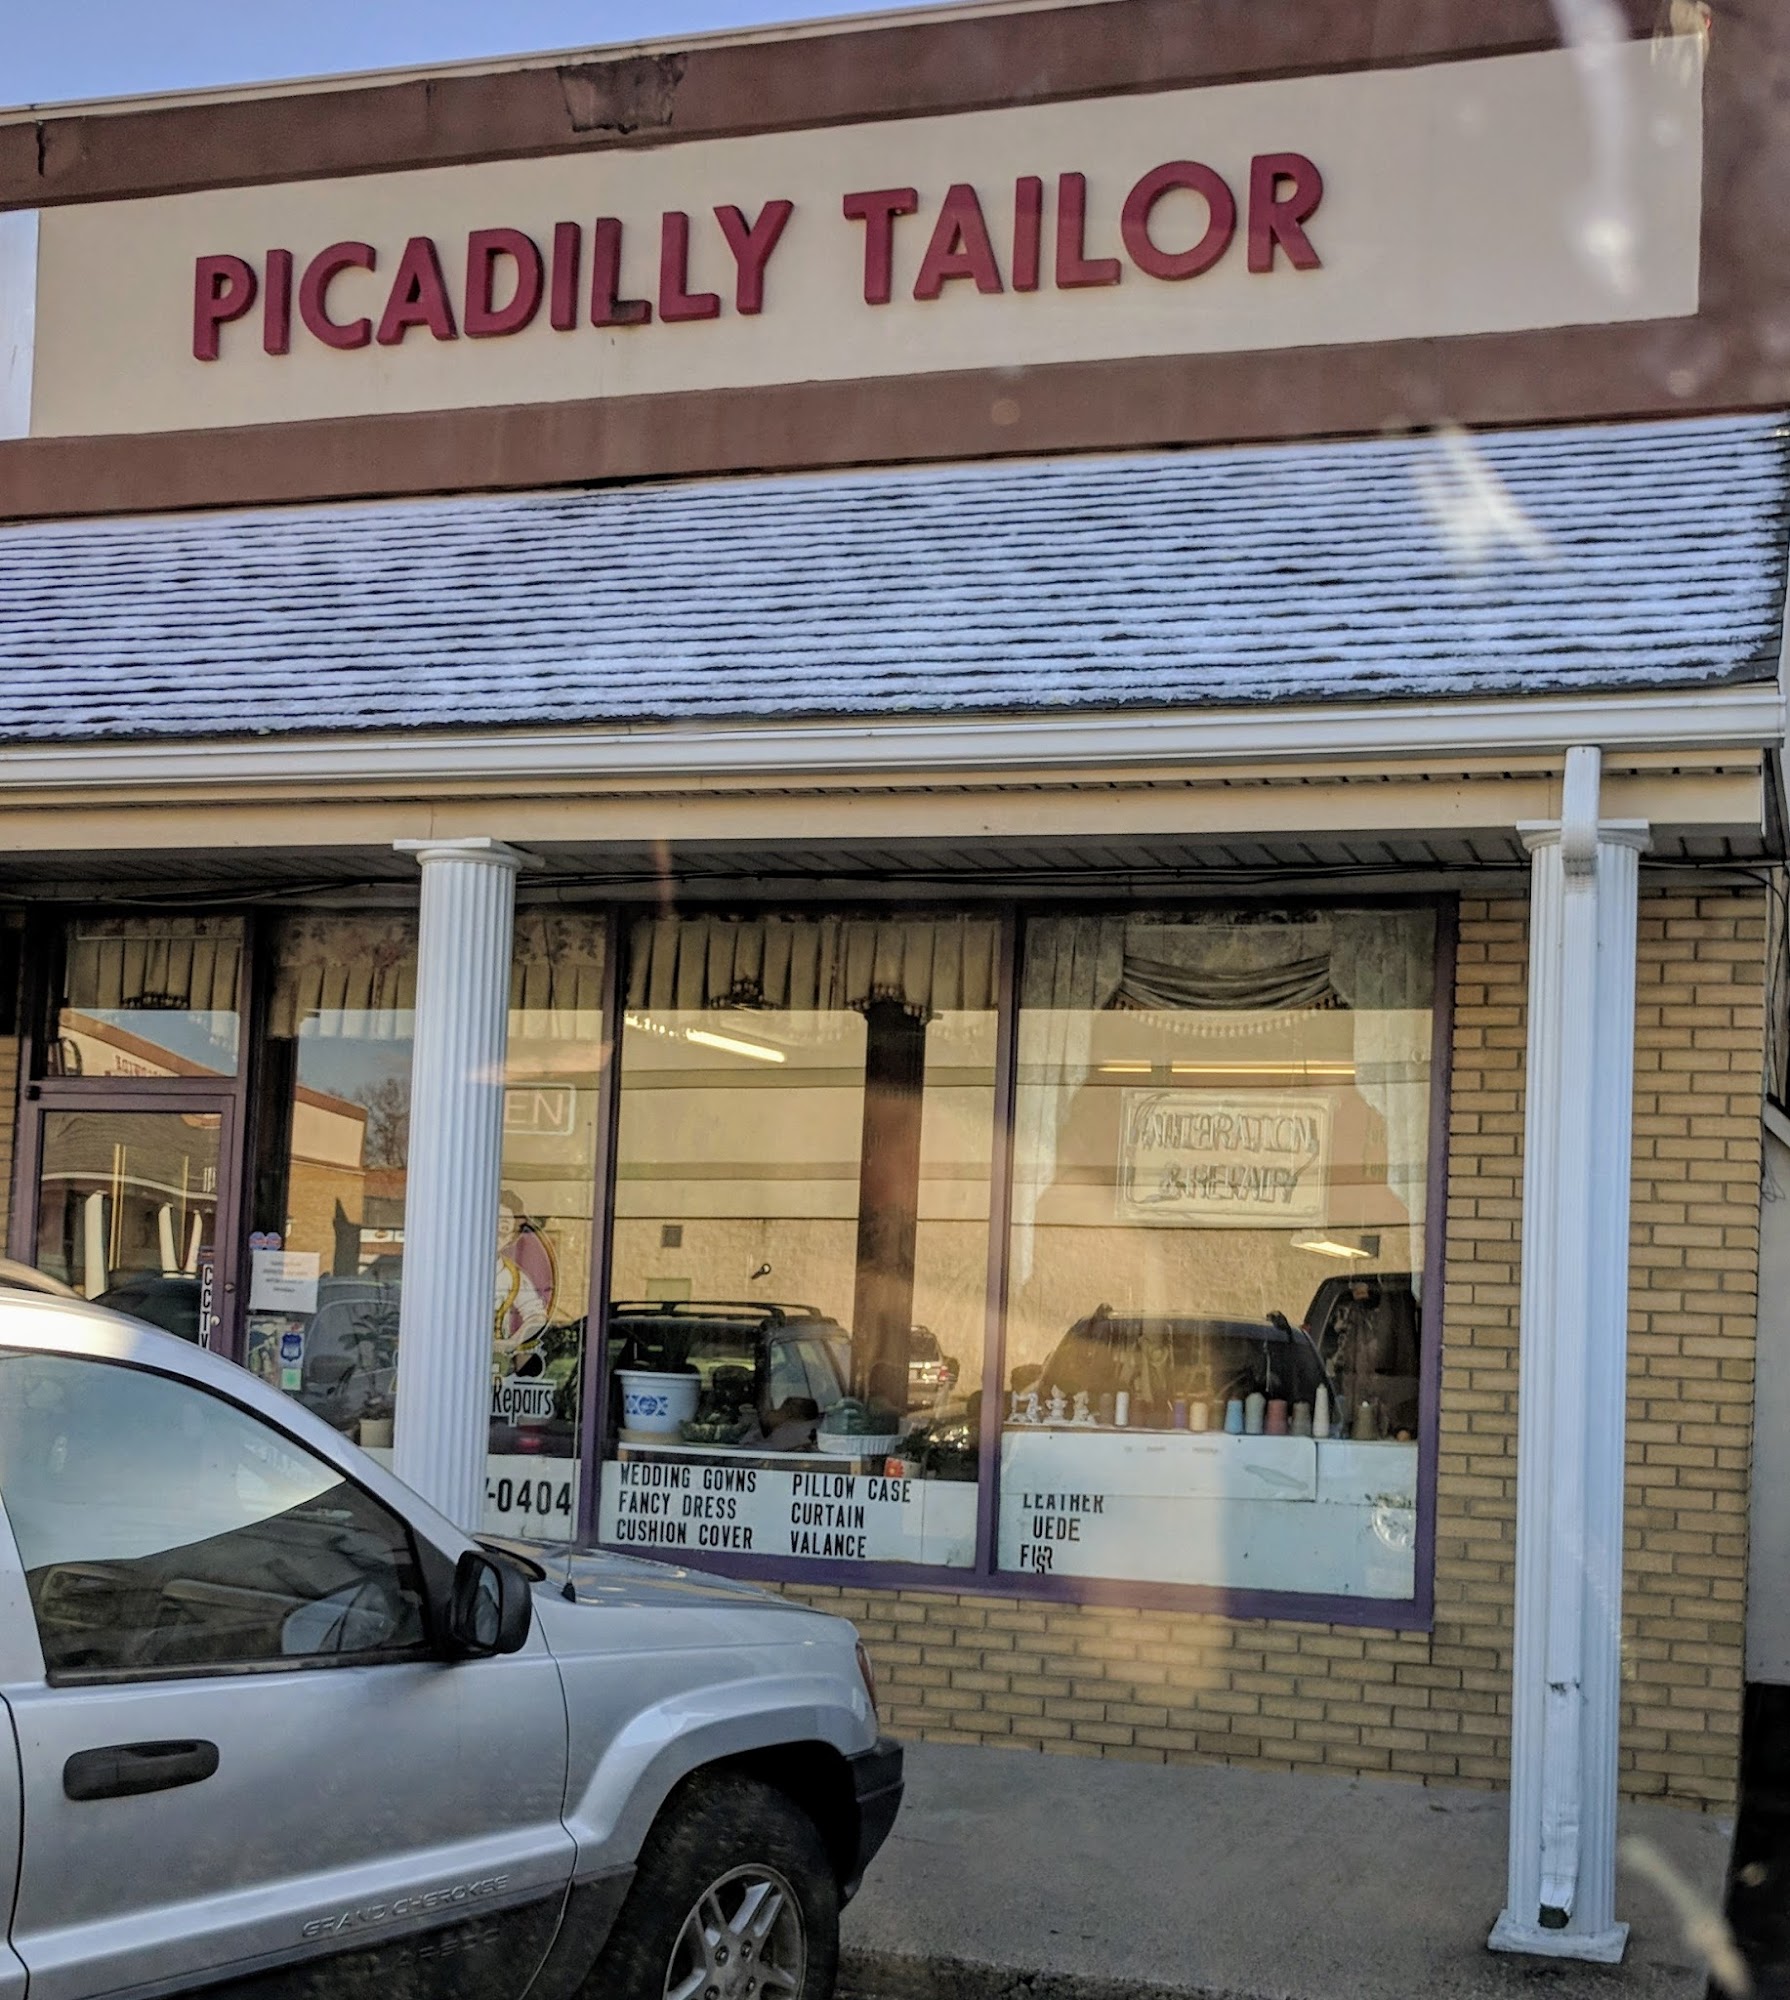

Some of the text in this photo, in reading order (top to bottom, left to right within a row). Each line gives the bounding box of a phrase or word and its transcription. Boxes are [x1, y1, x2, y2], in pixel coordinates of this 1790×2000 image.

[193, 152, 1323, 361] PICADILLY TAILOR
[503, 1090, 563, 1126] EN
[492, 1377, 553, 1424] Repairs
[620, 1463, 756, 1493] WEDDING GOWNS
[792, 1474, 911, 1502] PILLOW CASE
[484, 1477, 571, 1516] -0404
[619, 1491, 736, 1519] FANCY DRESS
[791, 1502, 864, 1529] CURTAIN
[1033, 1515, 1081, 1541] UEDE
[616, 1518, 752, 1549] CUSHION COVER
[790, 1530, 867, 1558] VALANCE
[303, 1874, 509, 1937] GRAND CHEROKEE
